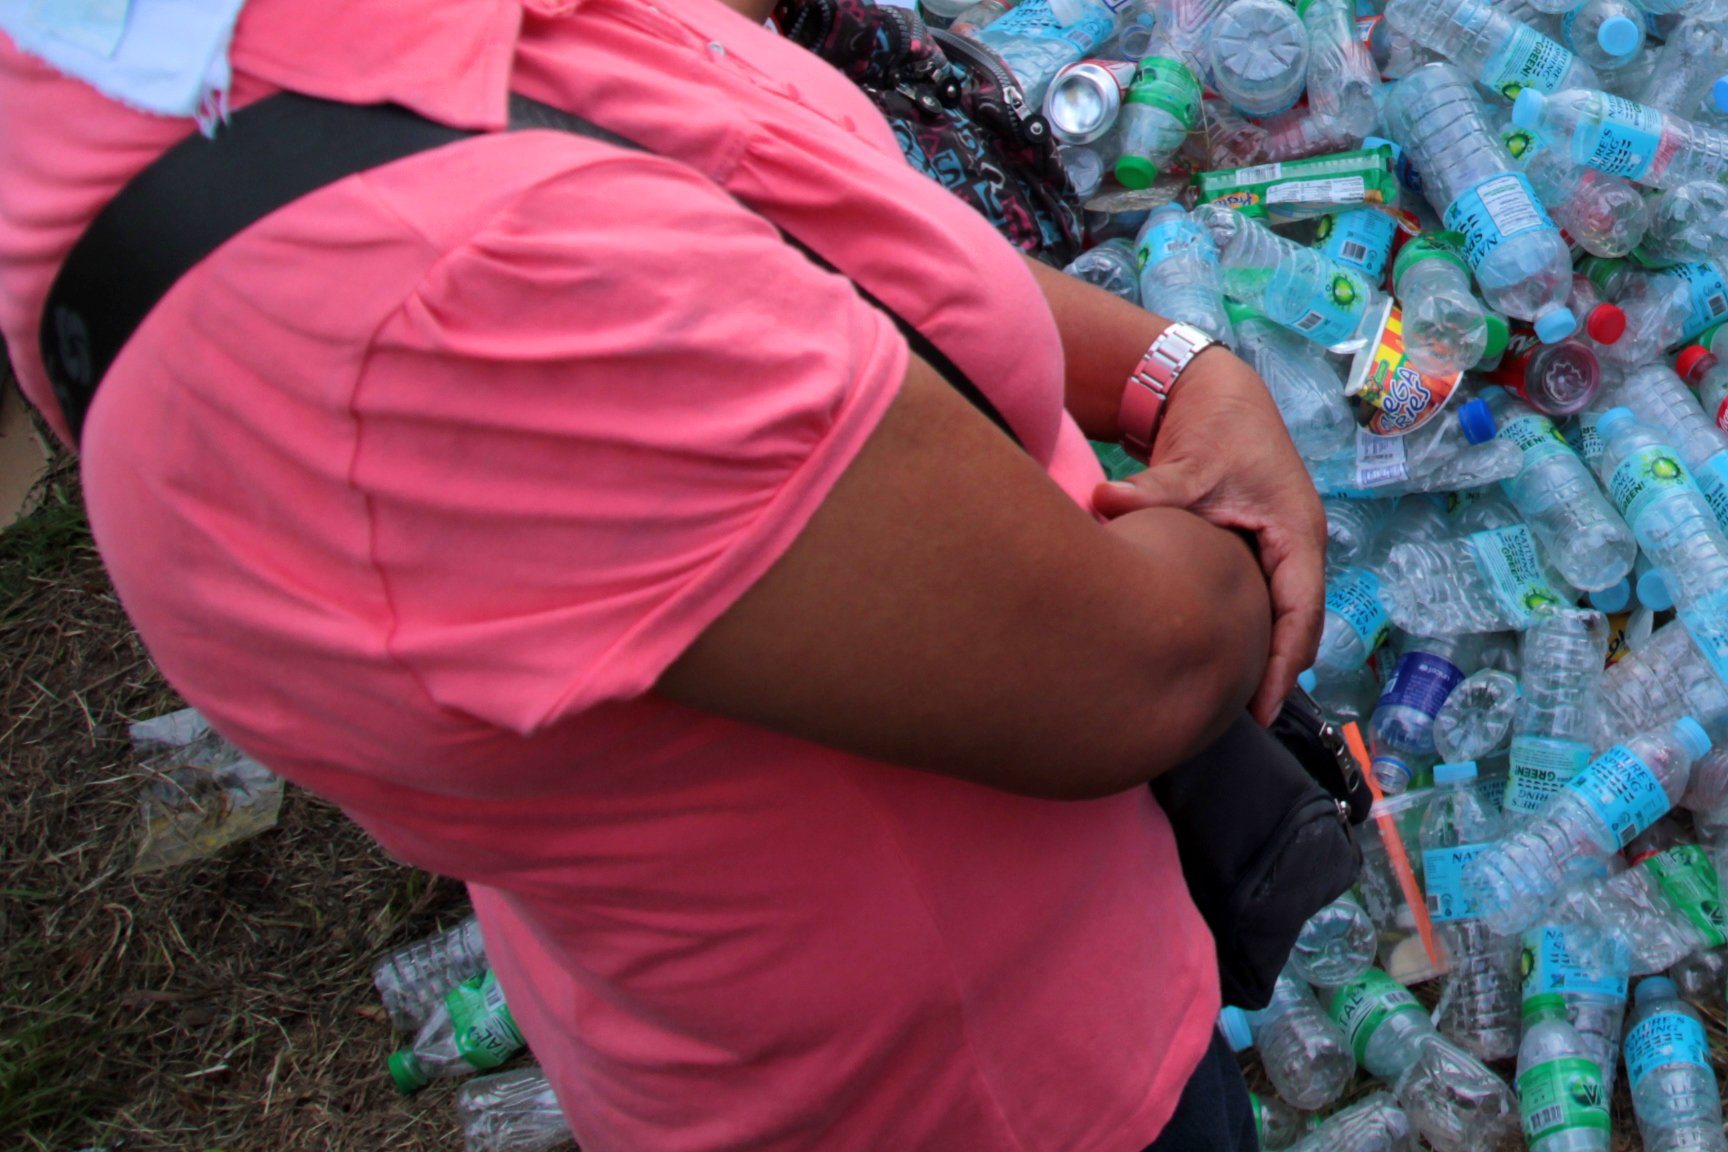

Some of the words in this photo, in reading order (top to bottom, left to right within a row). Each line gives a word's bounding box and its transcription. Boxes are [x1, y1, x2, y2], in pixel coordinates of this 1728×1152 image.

[1523, 40, 1544, 79] GREEN!
[1588, 128, 1613, 167] TURE'S
[1397, 380, 1431, 428] RIES
[1520, 436, 1547, 452] EEN!
[1622, 481, 1646, 510] REEN!
[1502, 547, 1525, 585] GREEN!
[1513, 534, 1533, 579] SPRING
[1514, 765, 1556, 782] GREEN!
[1603, 754, 1642, 794] SPRING
[1517, 789, 1549, 802] RING
